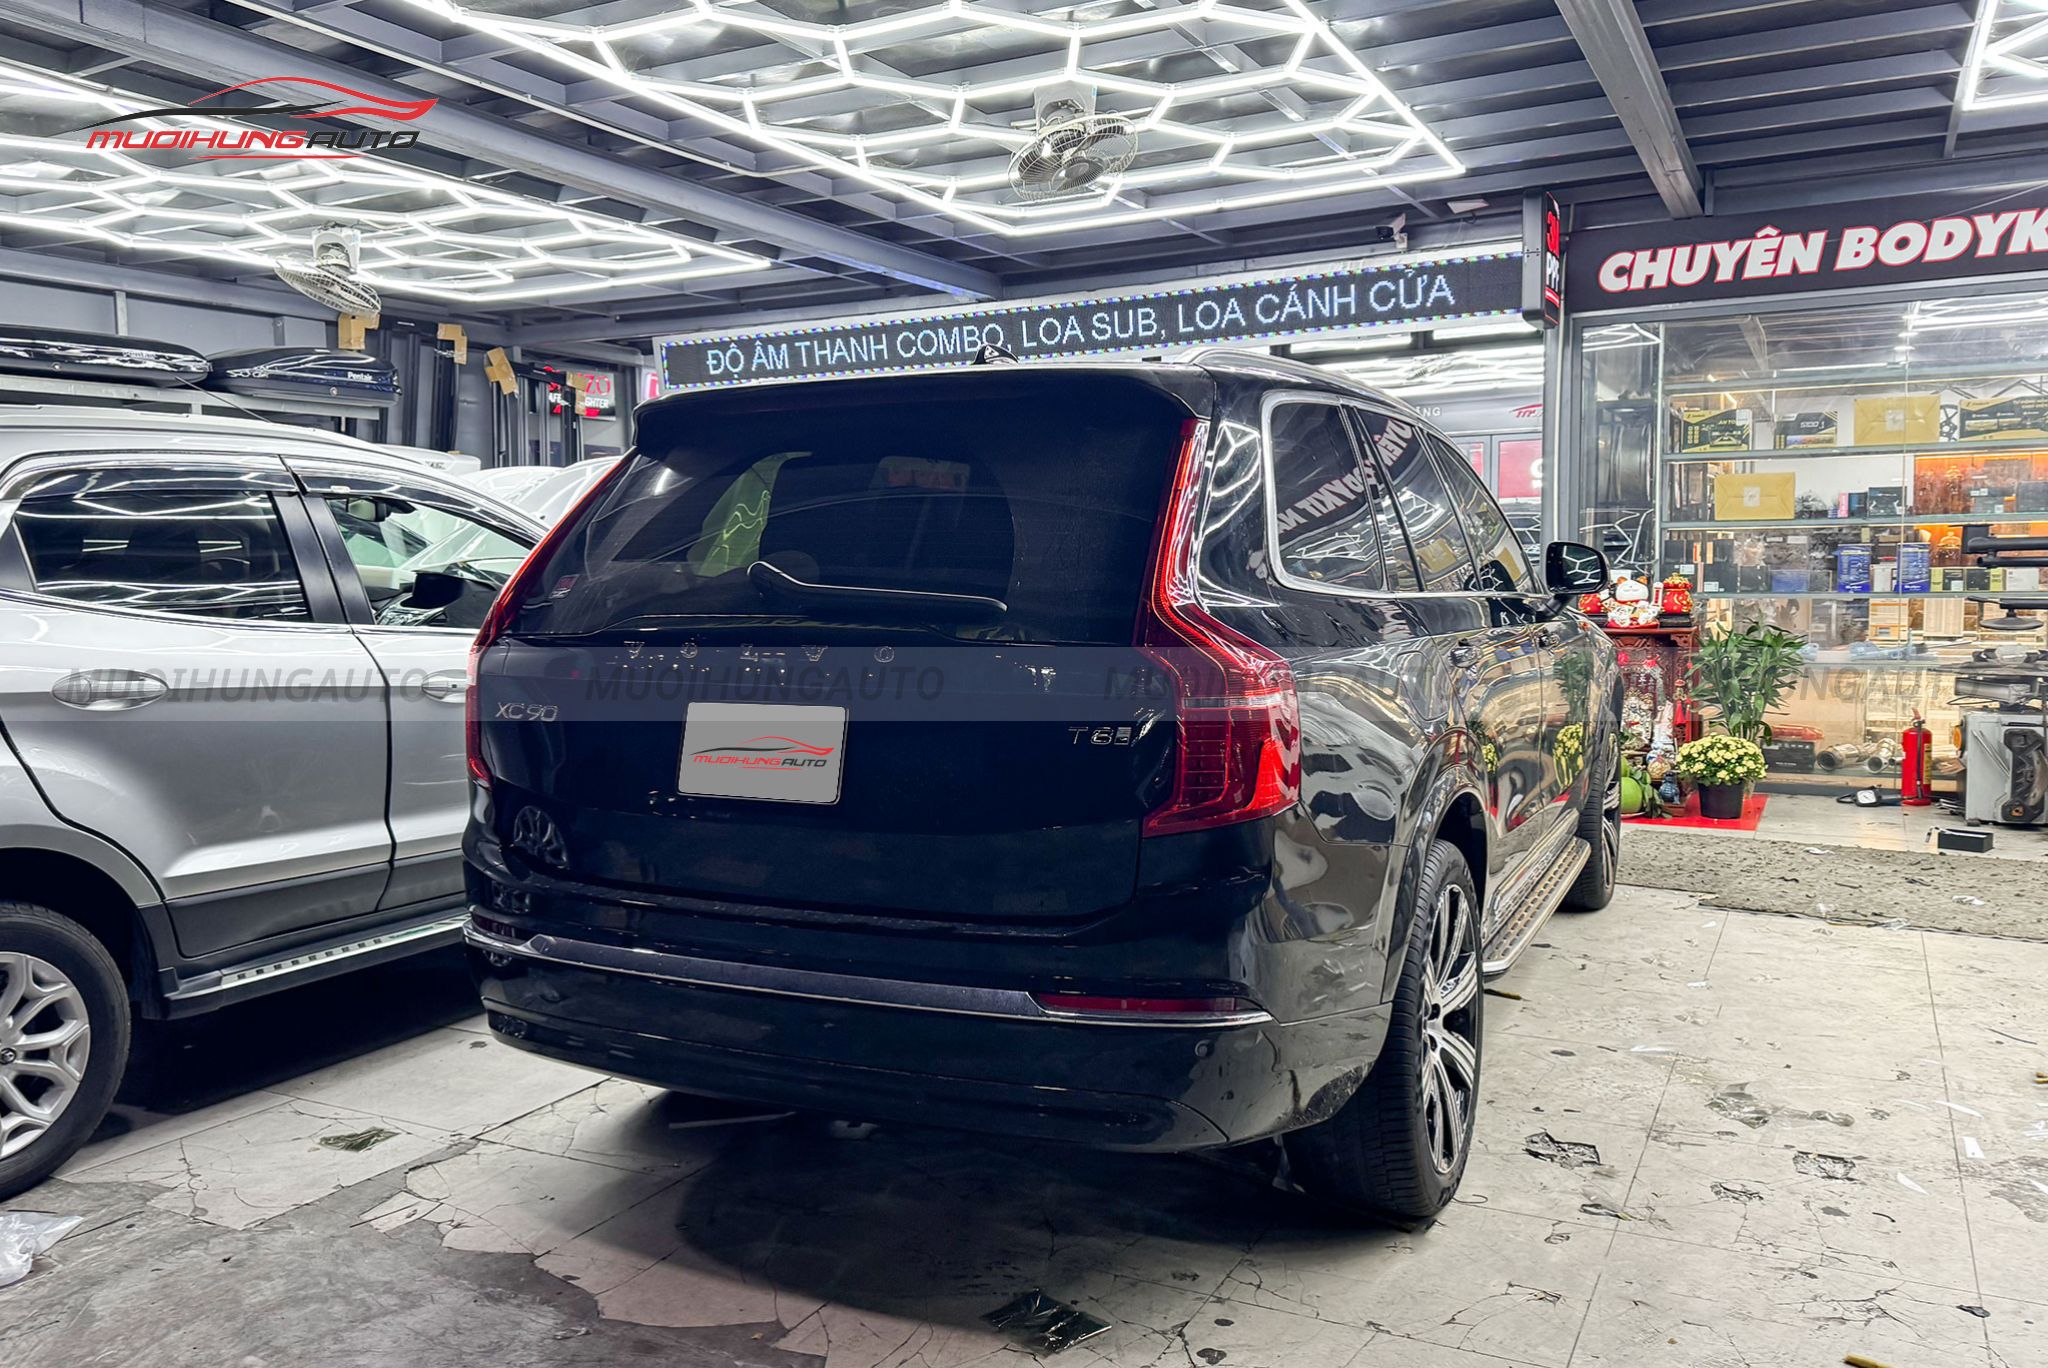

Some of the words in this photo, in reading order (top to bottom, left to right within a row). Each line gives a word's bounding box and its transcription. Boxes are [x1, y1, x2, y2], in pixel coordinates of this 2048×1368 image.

[1598, 225, 1829, 293] CHUYÊN
[706, 343, 744, 378] ĐỘ
[751, 342, 790, 372] ÂM
[795, 334, 889, 368] THANH
[1022, 317, 1083, 347] LOA
[1092, 308, 1165, 340] SUB,
[1178, 298, 1246, 333] LOA
[1256, 285, 1355, 325] CÁNH
[1369, 269, 1455, 312] CỬA
[624, 640, 895, 663] VOLVO
[494, 701, 559, 722] XC90
